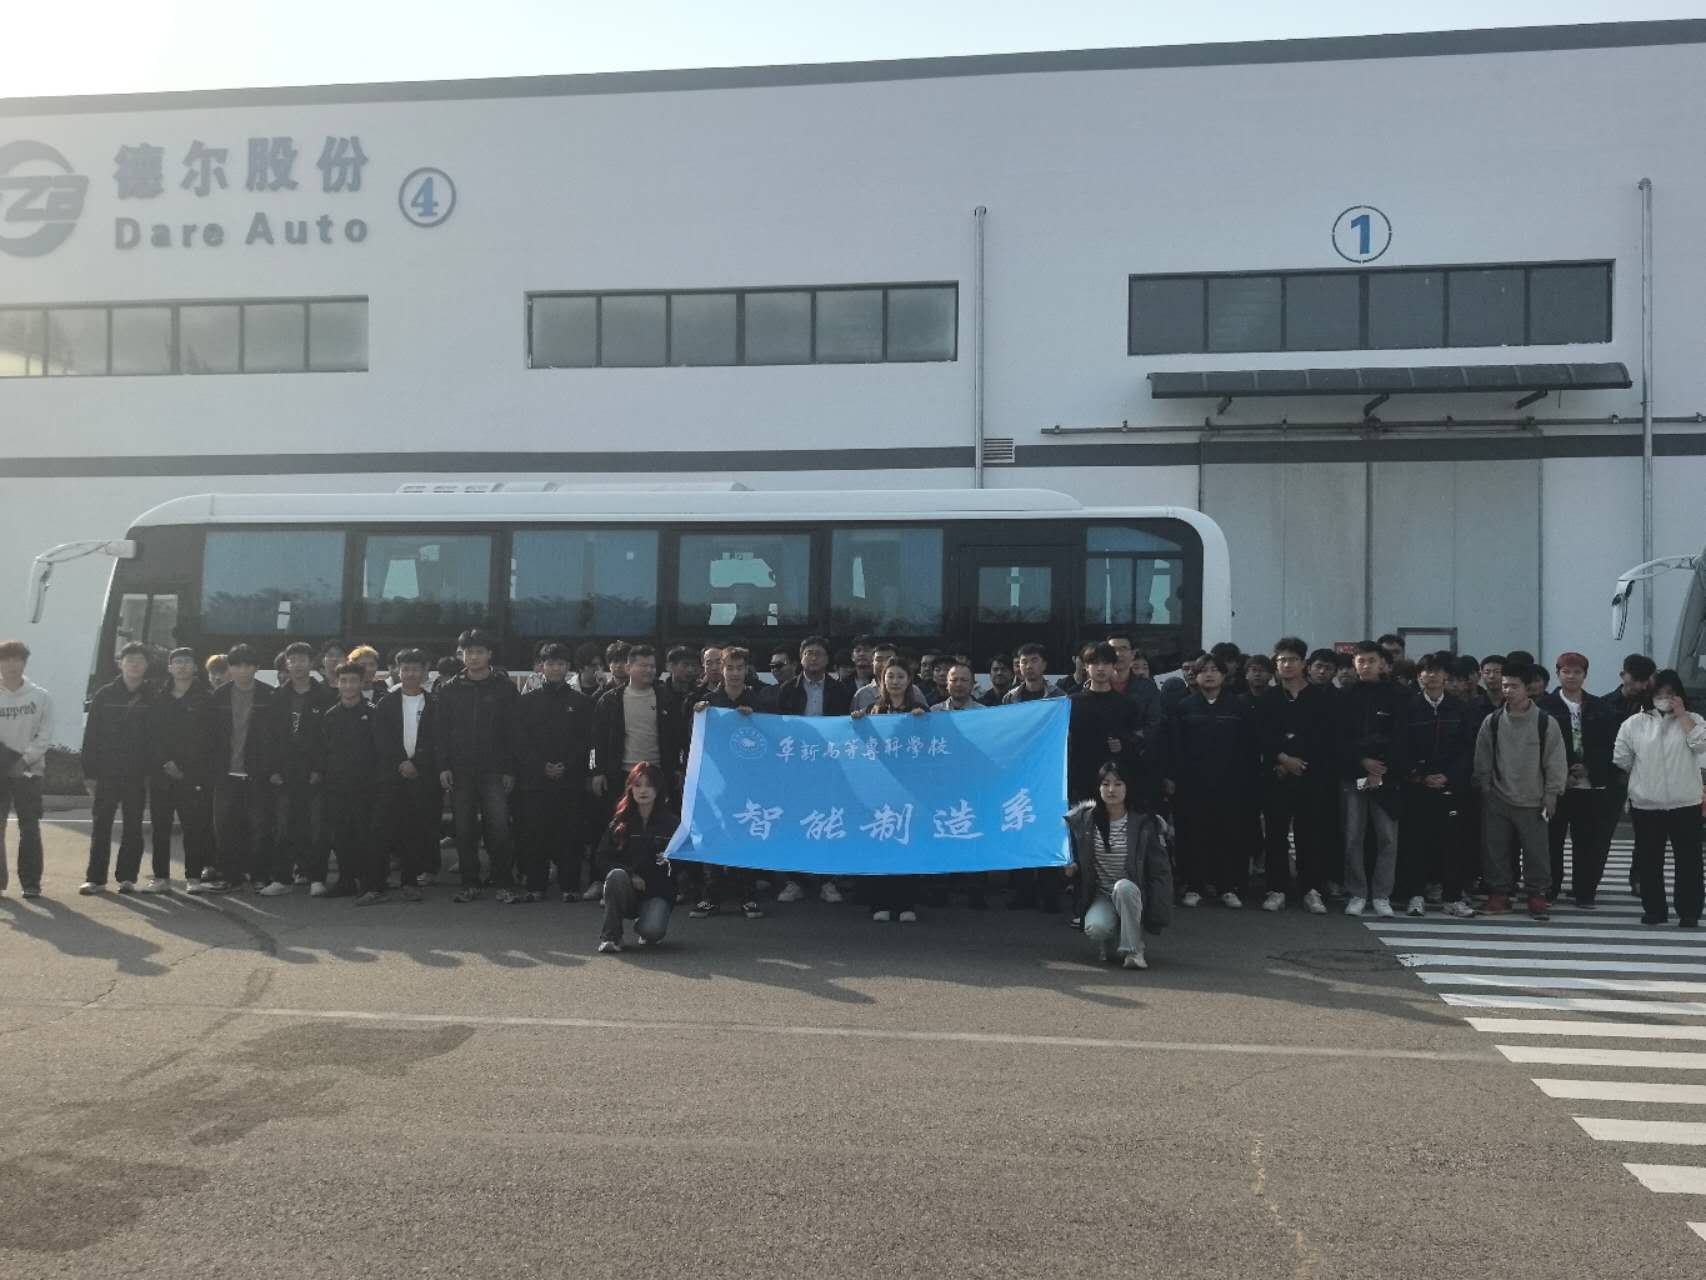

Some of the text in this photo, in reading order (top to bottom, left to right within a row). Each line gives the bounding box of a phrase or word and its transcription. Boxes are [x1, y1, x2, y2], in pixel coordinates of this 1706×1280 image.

[112, 136, 369, 199] 德尔股份
[114, 211, 368, 251] Dare Auto
[732, 788, 1037, 845] 智能制造系
